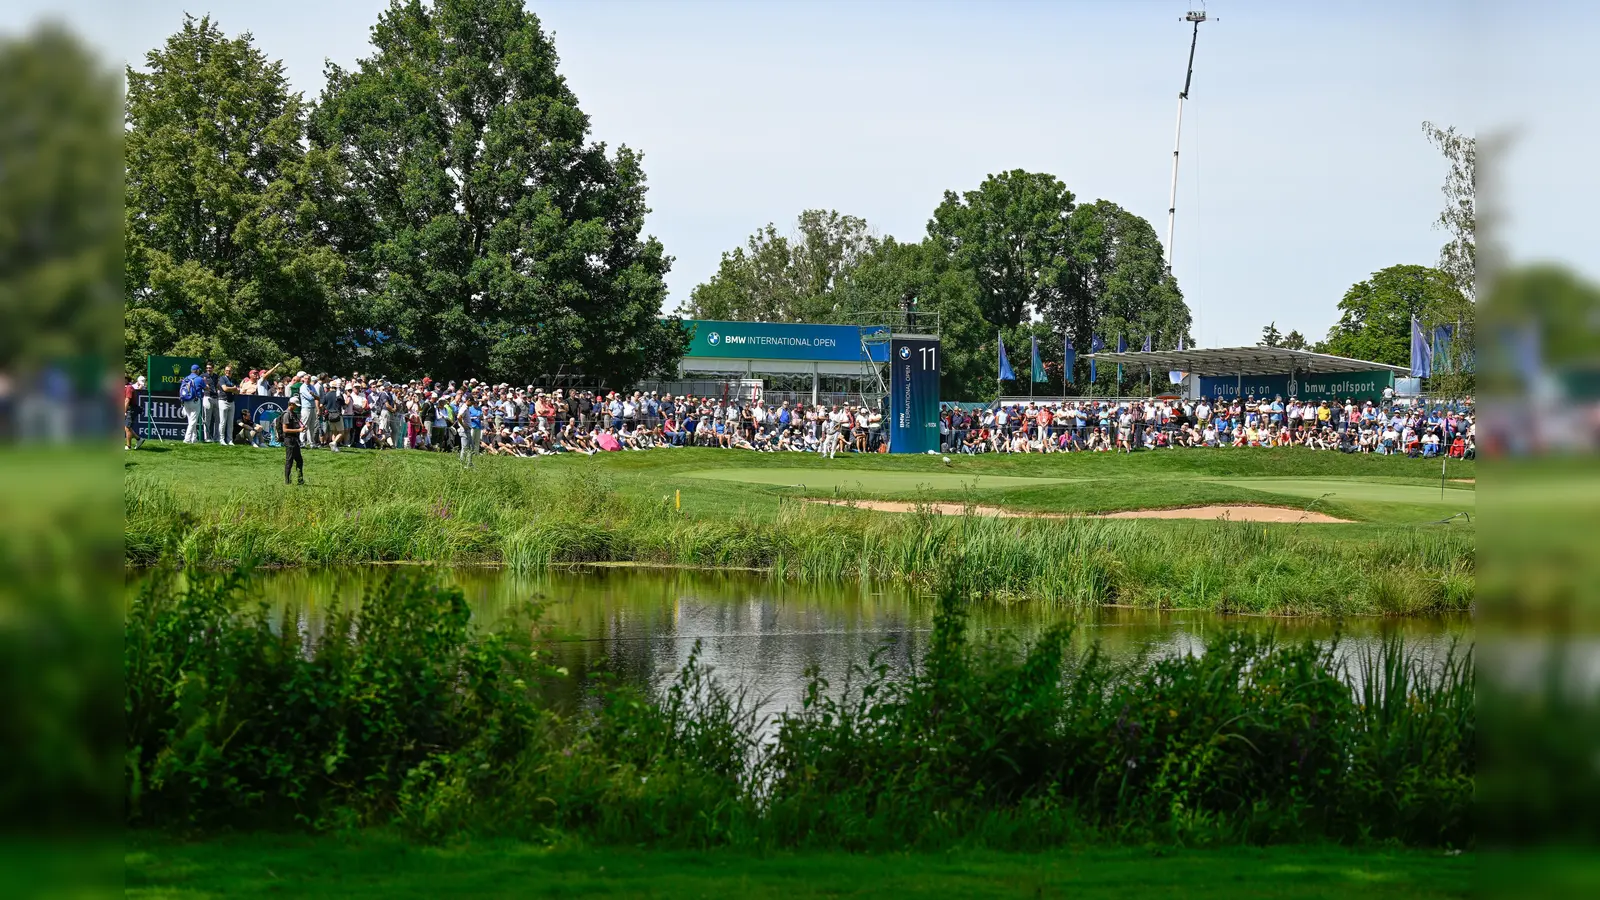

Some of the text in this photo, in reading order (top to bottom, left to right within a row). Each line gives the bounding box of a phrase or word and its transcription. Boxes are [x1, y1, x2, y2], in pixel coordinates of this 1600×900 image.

[725, 335, 836, 347] BMW INTERNATIONAL OPEN
[919, 347, 936, 371] 11
[1213, 384, 1270, 395] follow us on
[1304, 381, 1375, 394] bmw_golfsport
[160, 428, 178, 436] THE
